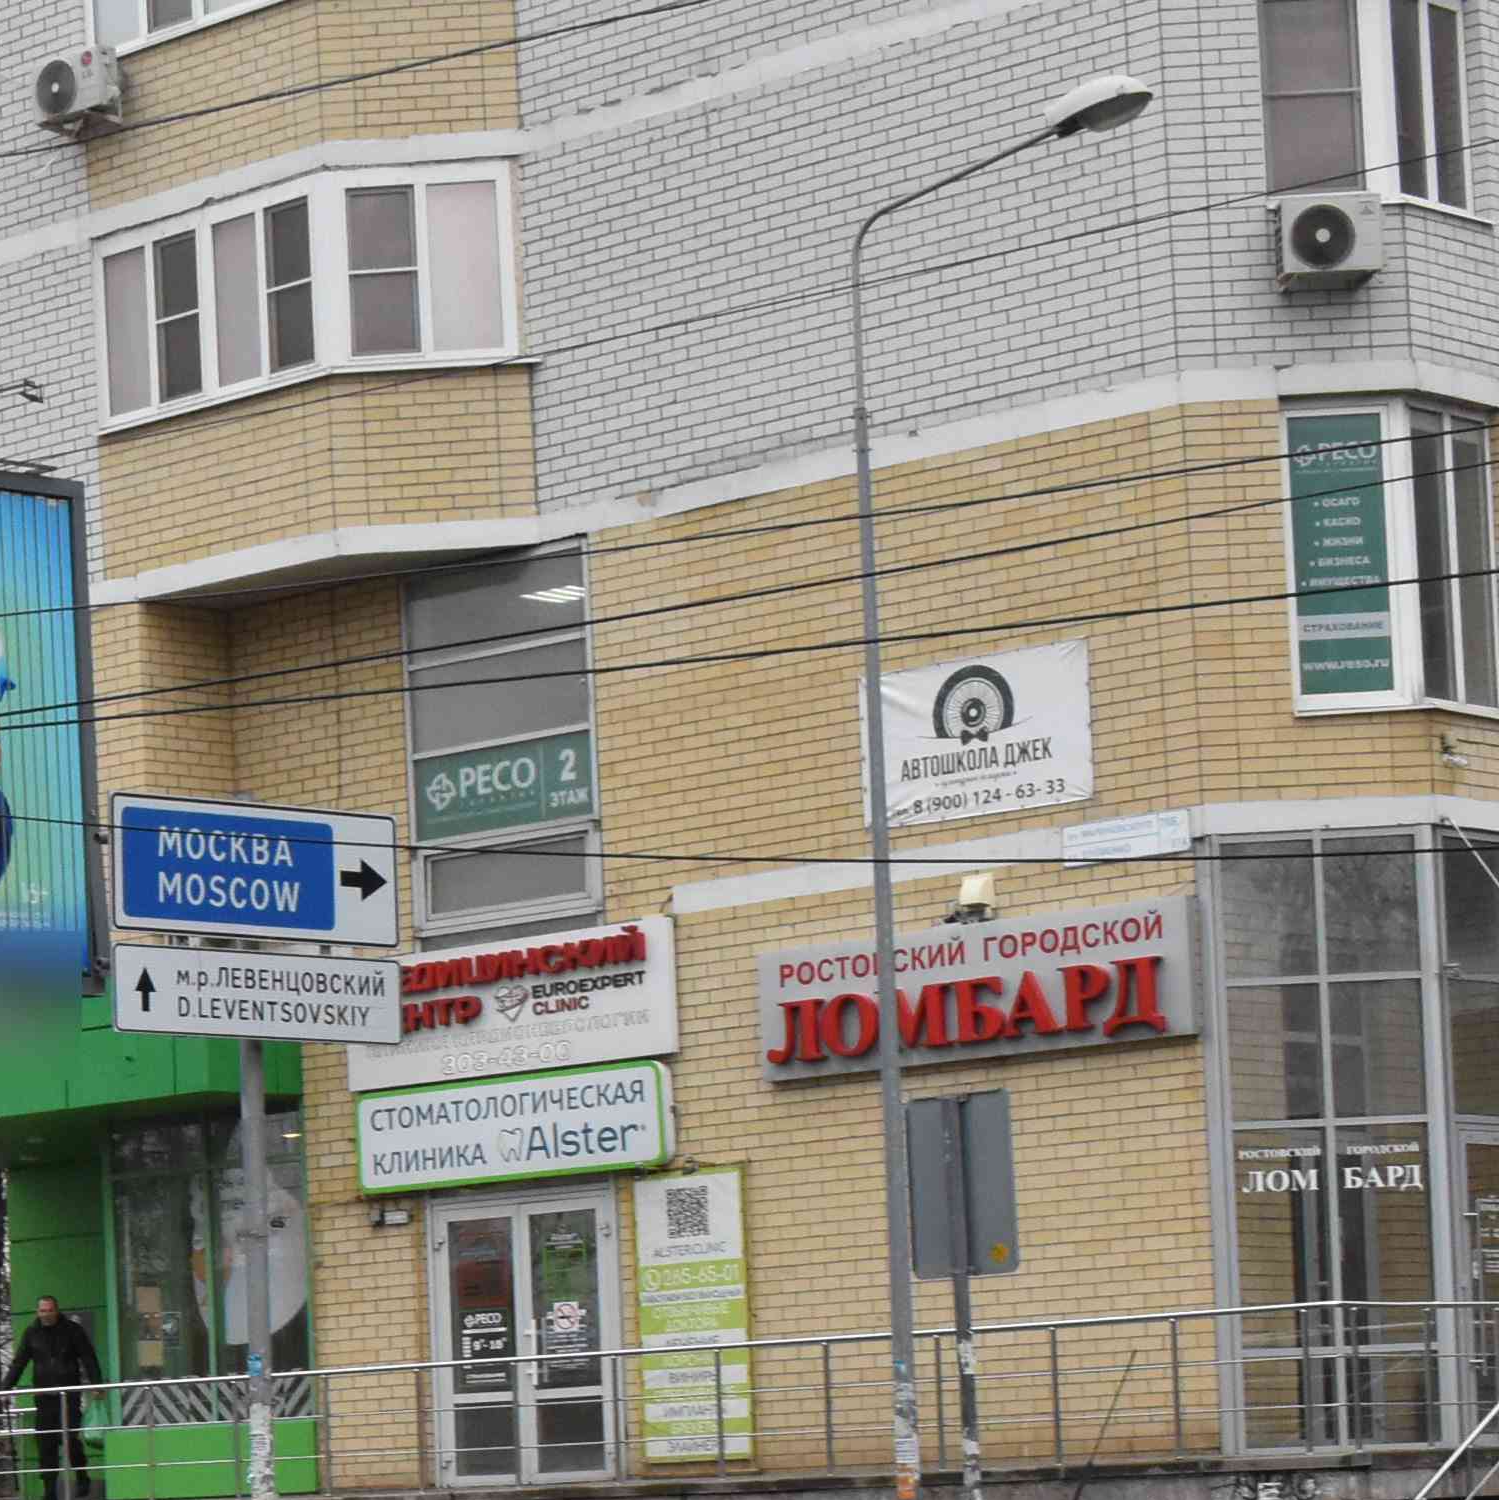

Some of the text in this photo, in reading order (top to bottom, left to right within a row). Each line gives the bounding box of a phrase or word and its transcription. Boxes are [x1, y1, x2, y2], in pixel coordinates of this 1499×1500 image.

[1302, 620, 1385, 633] СТРАХОВАНИЕ
[458, 757, 537, 798] РЕСО
[558, 748, 577, 782] 2
[900, 745, 1000, 783] АВТОШКОЛА
[1002, 736, 1054, 769] ДЖЕК
[548, 786, 591, 808] ЭТАЖ
[913, 799, 924, 815] 8
[157, 825, 295, 867] МОСКВА
[157, 871, 301, 913] MOSCOW
[402, 924, 647, 994] ЕДИЦИНСКИЙ
[778, 910, 1164, 988] РОСТОСКИЙ ГОРОДСКОЙ
[531, 970, 646, 1000] EUROEXPERT
[177, 996, 372, 1027] D.LEVENTSOVSKIY
[532, 996, 591, 1017] CLINIC
[766, 955, 1170, 1065] ЛОМБАРД
[369, 1079, 646, 1132] СТОМАТОЛОГИЧЕСКАЯ
[372, 1143, 488, 1177] КЛИНИКА
[526, 1123, 639, 1162] Alster
[1241, 1164, 1424, 1194] ЛОМ БАРД
